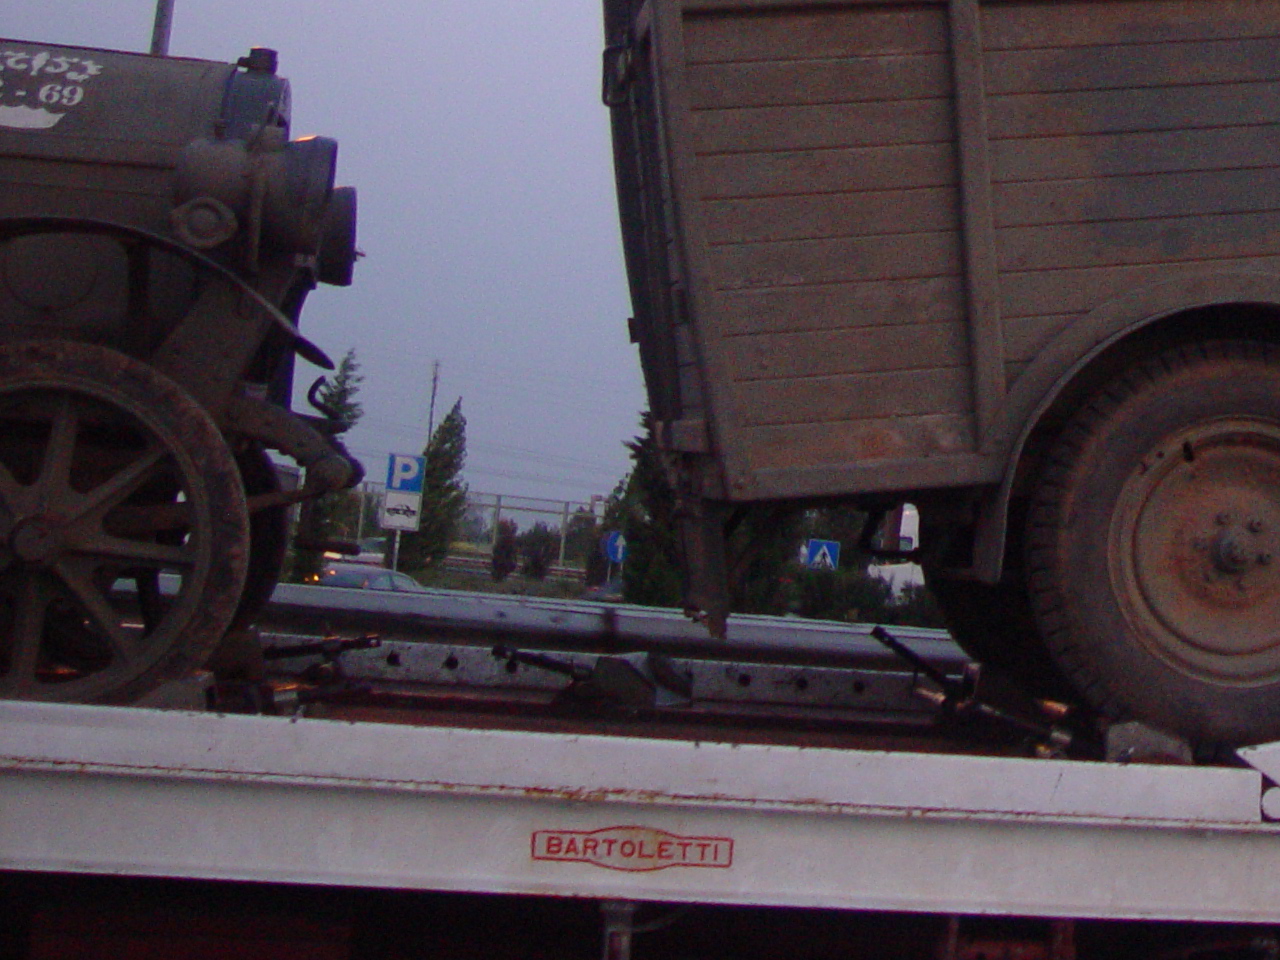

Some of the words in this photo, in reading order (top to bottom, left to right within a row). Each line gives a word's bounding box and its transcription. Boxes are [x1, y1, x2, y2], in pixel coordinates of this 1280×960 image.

[39, 83, 84, 107] 69
[392, 456, 419, 488] P
[545, 835, 720, 862] BARTOLETTI
